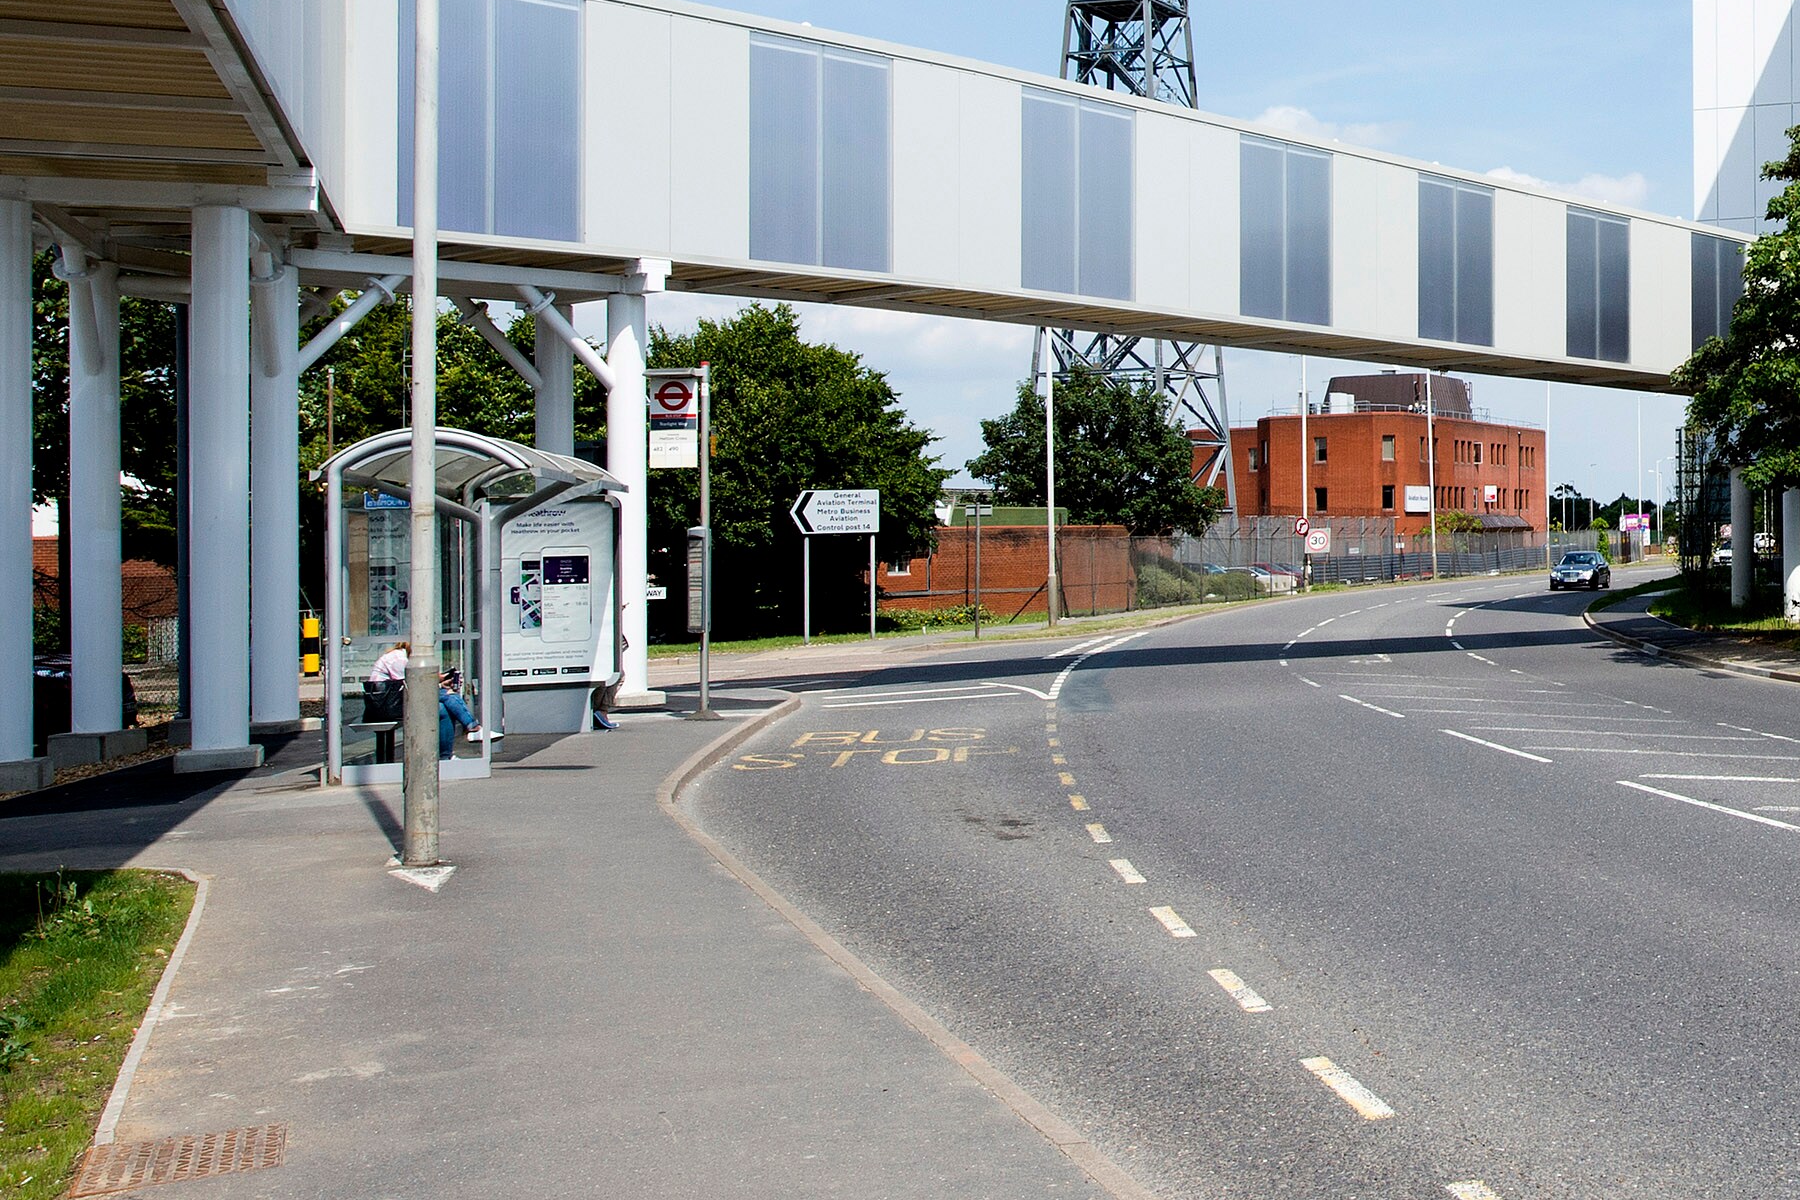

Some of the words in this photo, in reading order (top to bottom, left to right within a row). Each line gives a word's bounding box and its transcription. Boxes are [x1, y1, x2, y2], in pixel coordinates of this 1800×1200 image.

[845, 524, 861, 533] post
[1311, 536, 1326, 545] 30
[790, 727, 987, 748] BUS
[732, 745, 1019, 771] STOP
